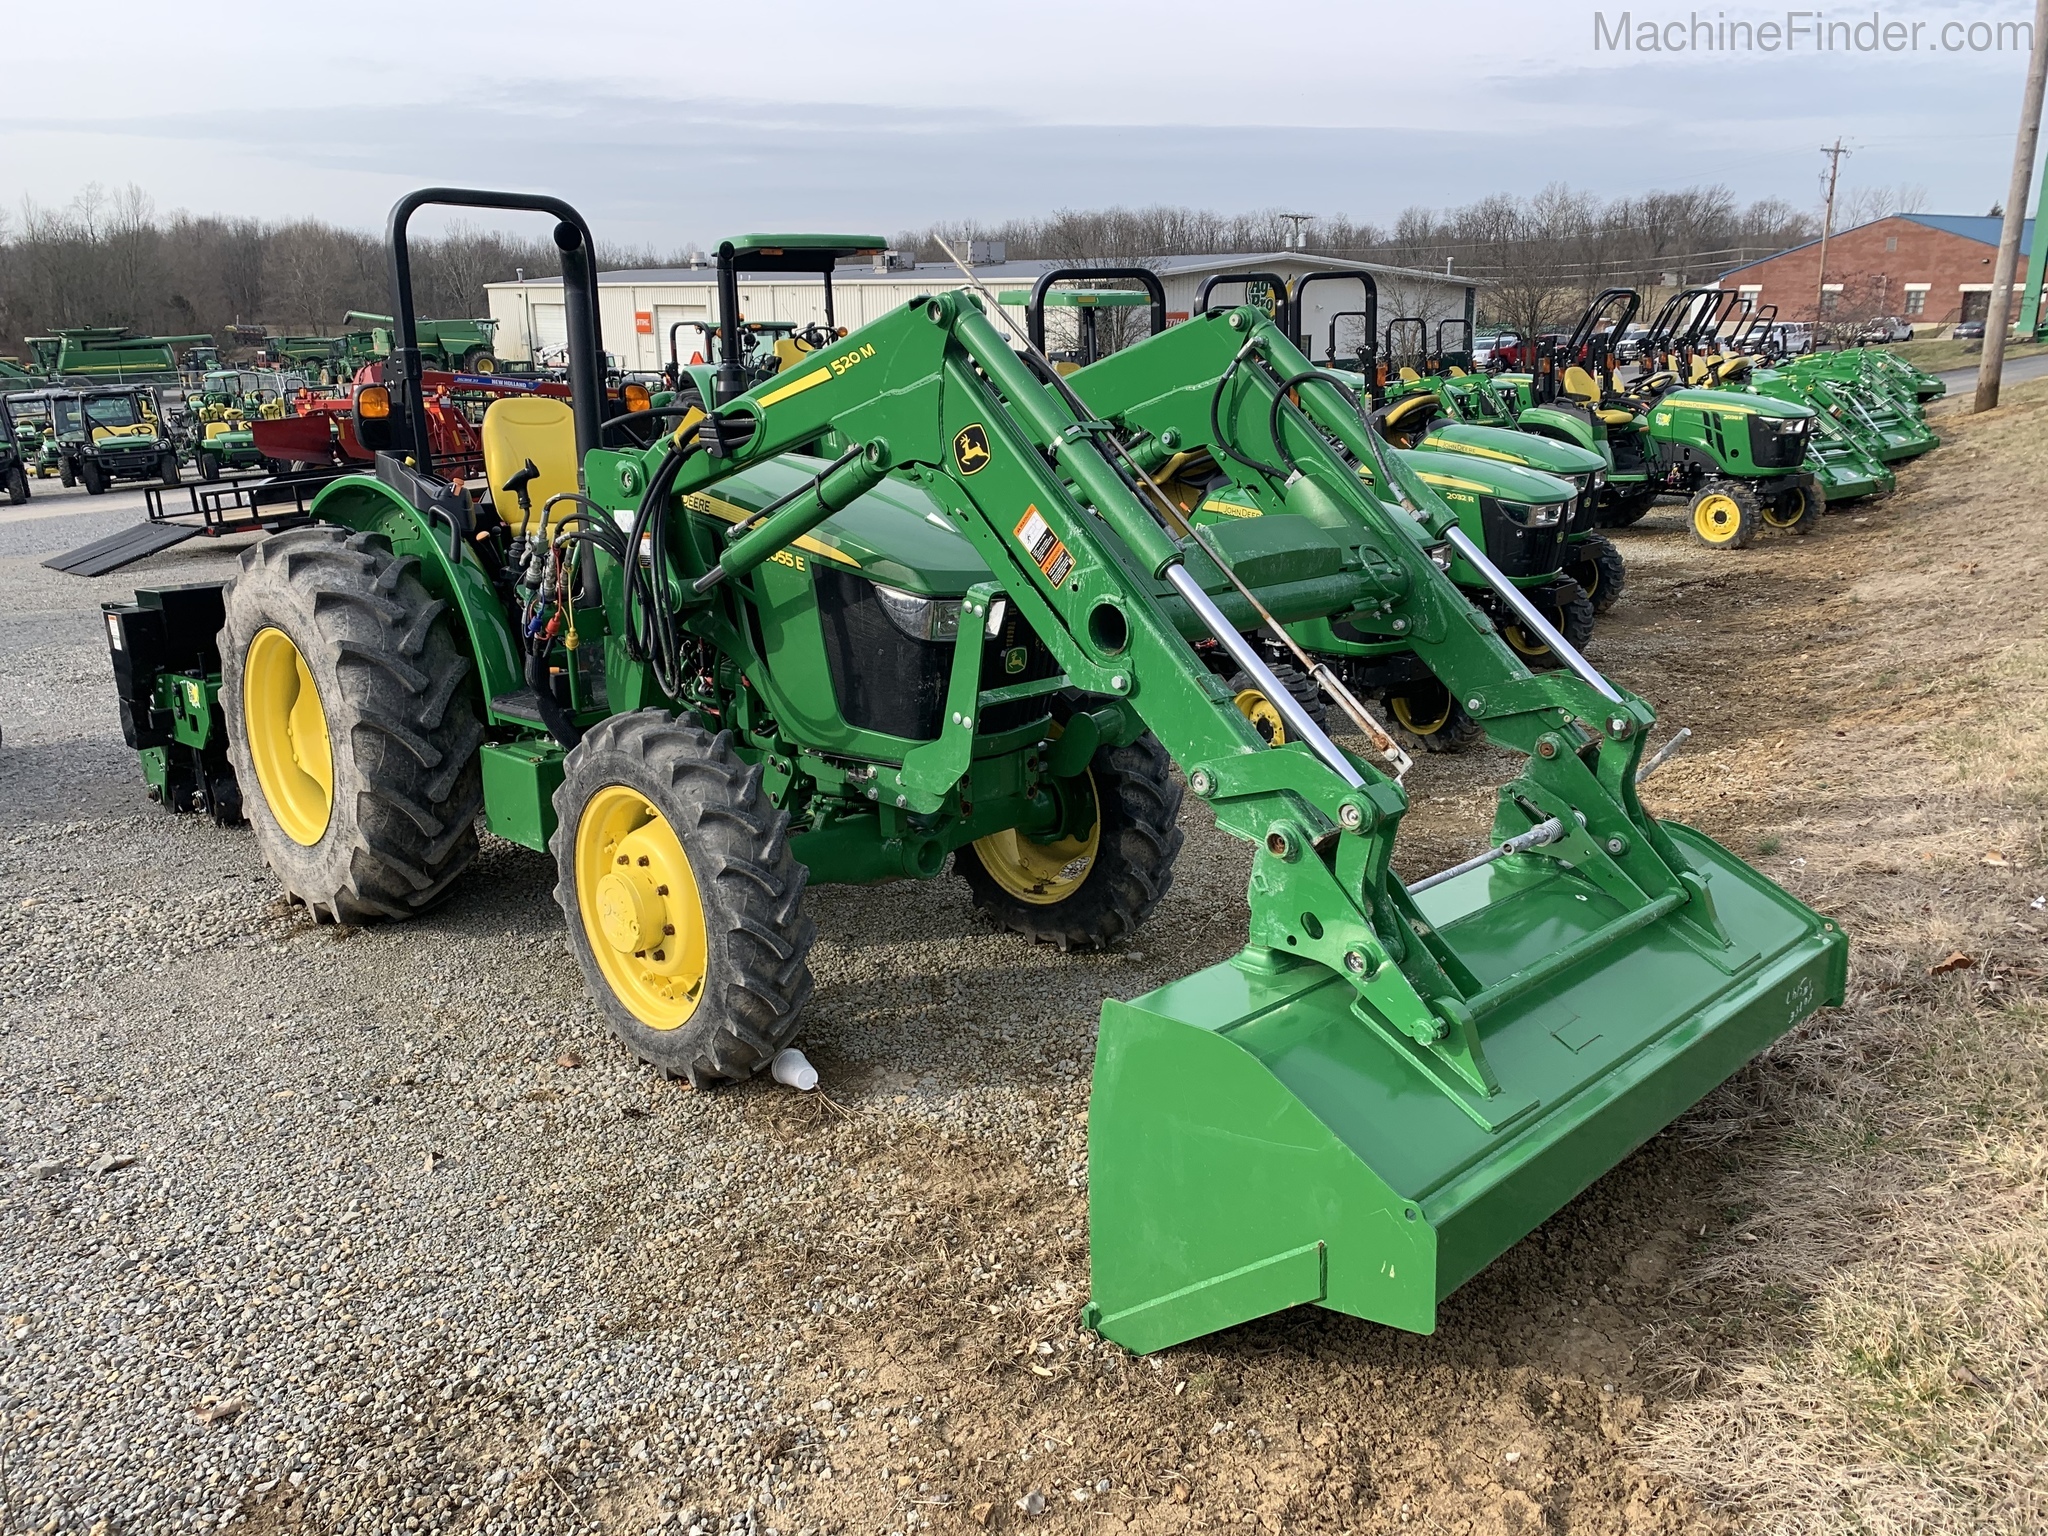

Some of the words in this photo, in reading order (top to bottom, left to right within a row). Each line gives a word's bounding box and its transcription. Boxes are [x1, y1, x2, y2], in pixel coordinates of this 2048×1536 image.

[830, 351, 861, 376] 520
[859, 343, 876, 359] M
[1223, 505, 1241, 515] JOHN
[766, 550, 794, 567] 055
[795, 555, 806, 572] E
